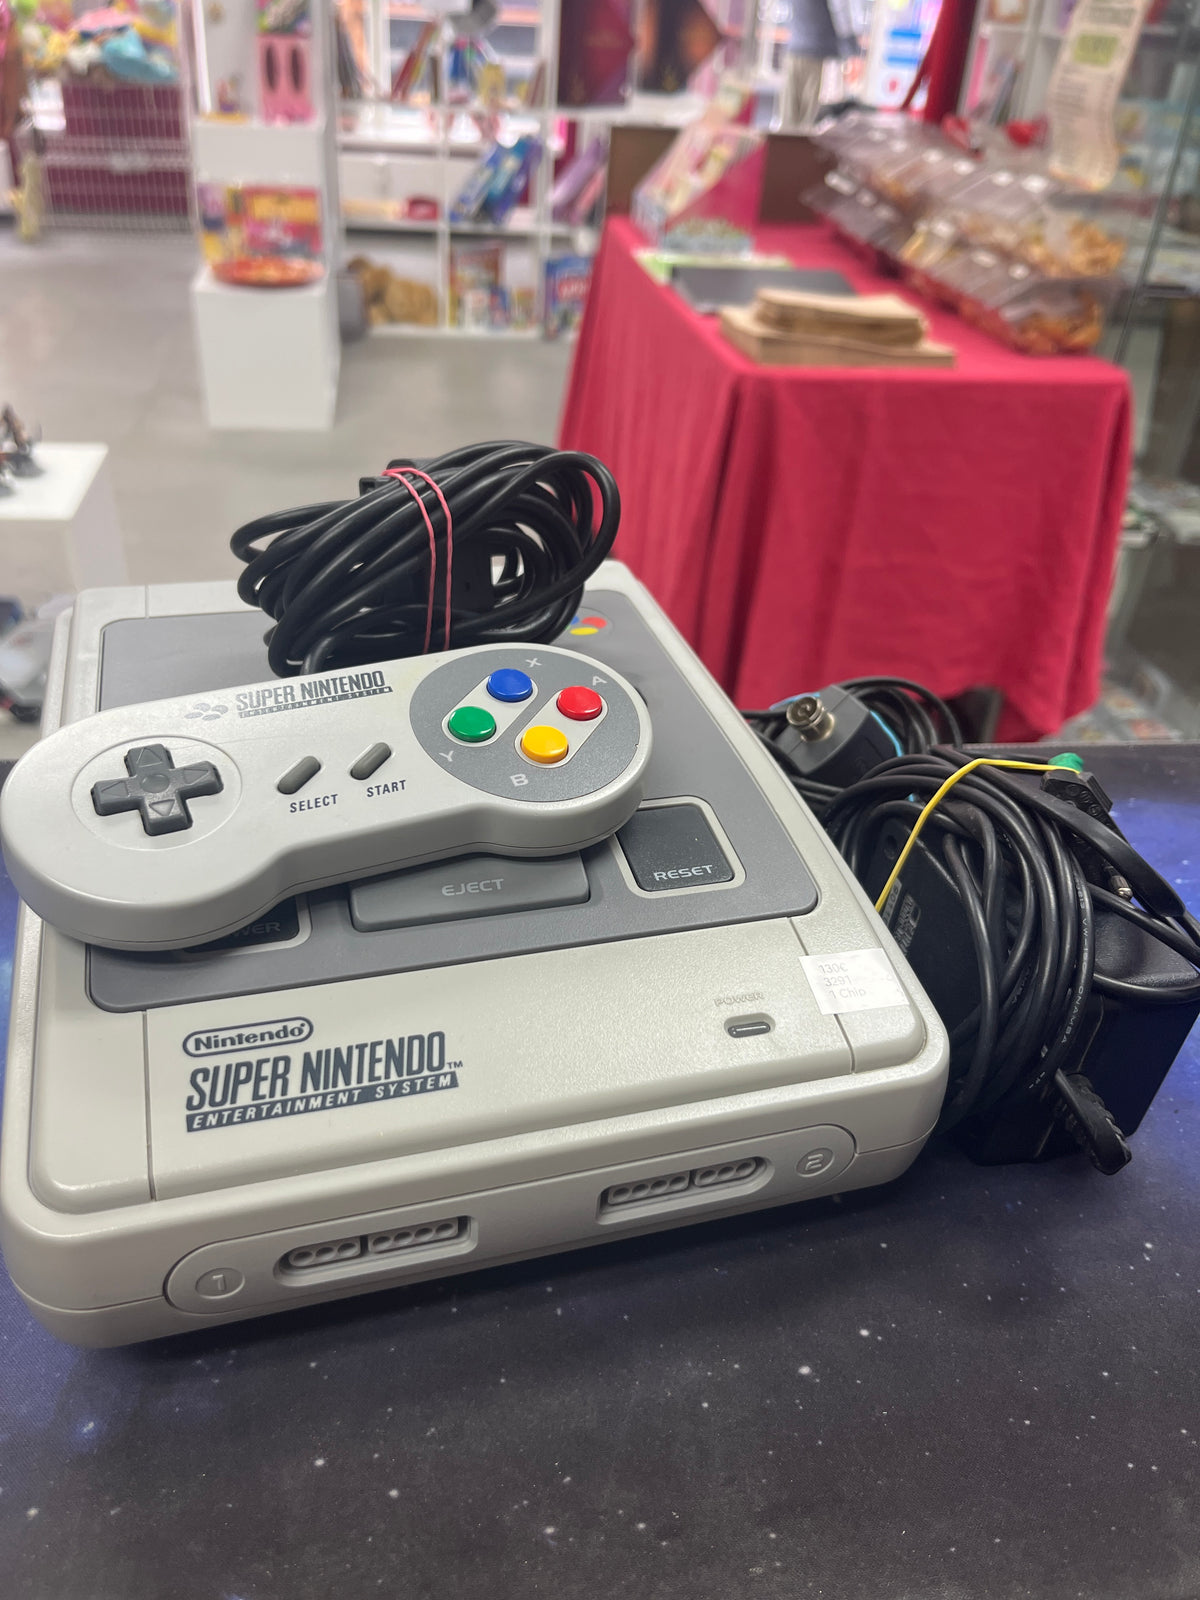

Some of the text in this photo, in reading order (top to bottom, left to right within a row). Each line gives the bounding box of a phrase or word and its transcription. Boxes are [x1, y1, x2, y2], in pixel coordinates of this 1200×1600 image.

[525, 657, 542, 668] X
[592, 675, 607, 686] A
[235, 670, 385, 711] SUPER NINTENDO
[439, 750, 454, 762] Y
[366, 779, 406, 798] START
[510, 773, 529, 787] B
[289, 793, 338, 813] SELECT
[653, 864, 713, 881] RESET
[441, 878, 504, 896] EJECT
[818, 962, 848, 974] 130€
[194, 1022, 306, 1051] Nintendo
[186, 1055, 291, 1111] SUPER
[300, 1030, 446, 1093] NINTENDO
[192, 1074, 452, 1130] ENTERTAINMENT SYSTEM
